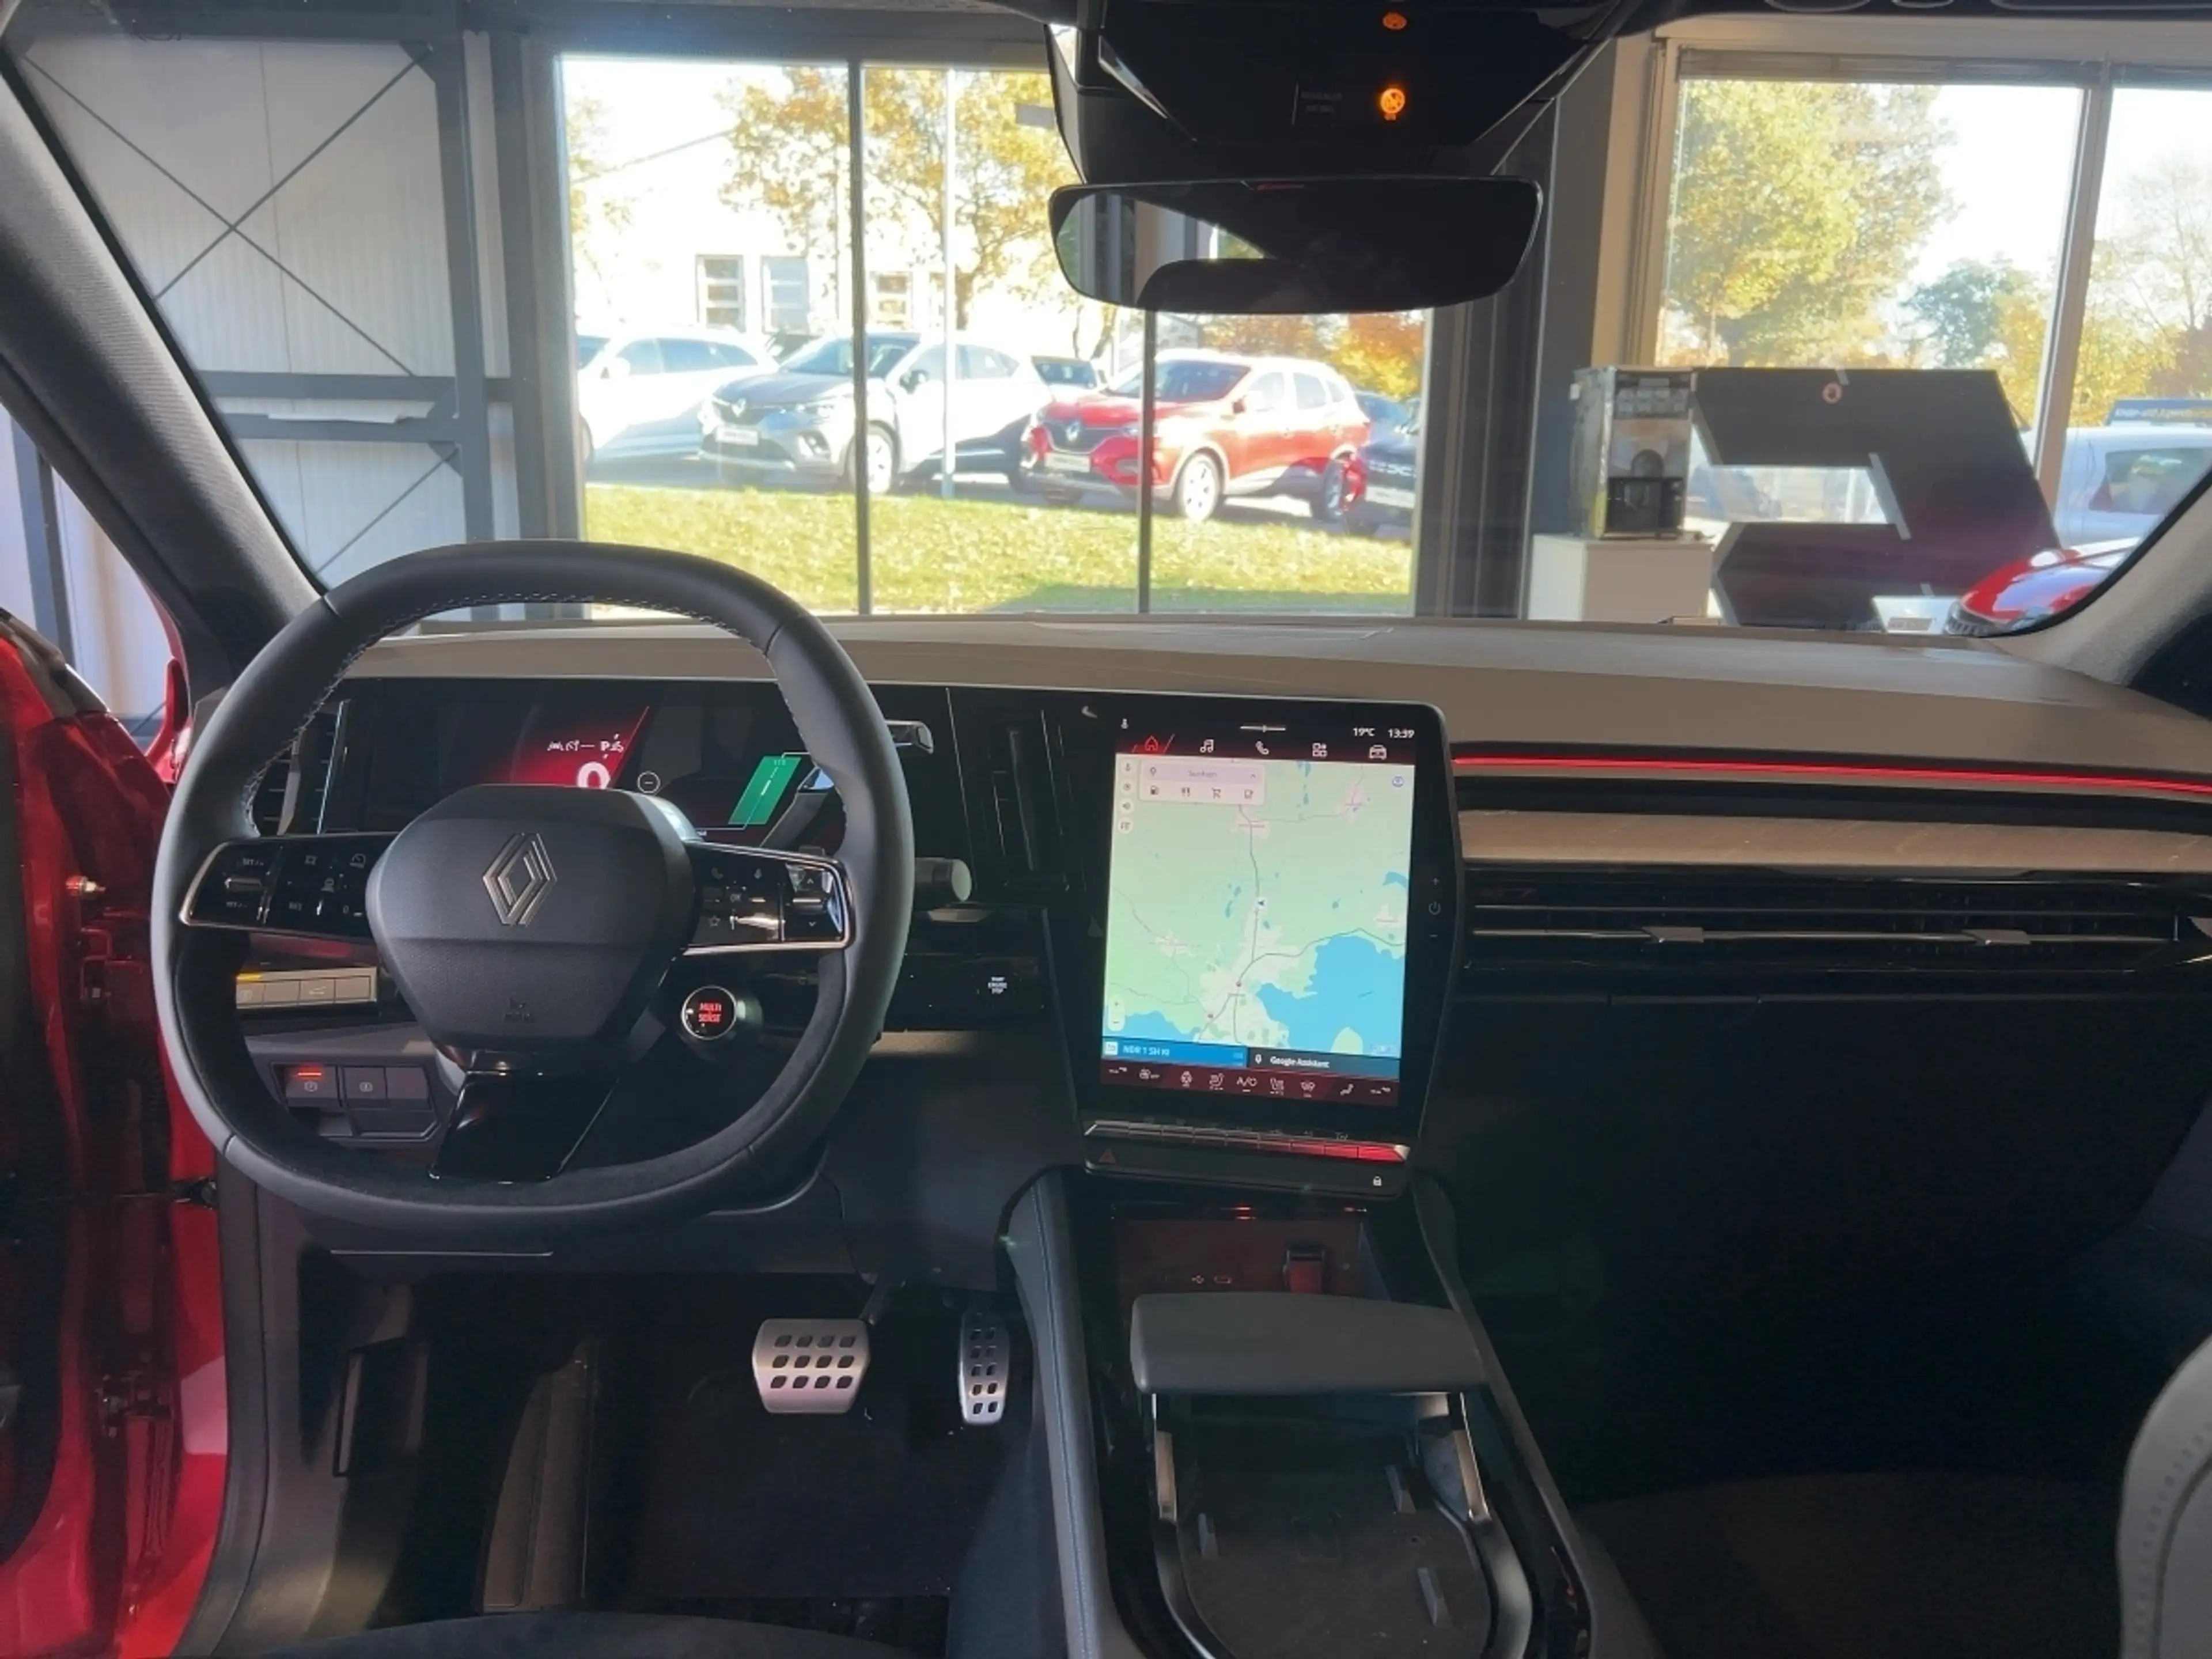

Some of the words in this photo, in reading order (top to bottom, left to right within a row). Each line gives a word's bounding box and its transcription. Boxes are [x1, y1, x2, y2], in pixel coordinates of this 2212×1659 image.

[699, 1002, 722, 1012] MULTI
[1270, 1056, 1297, 1067] Google
[1297, 1057, 1330, 1069] Assistant
